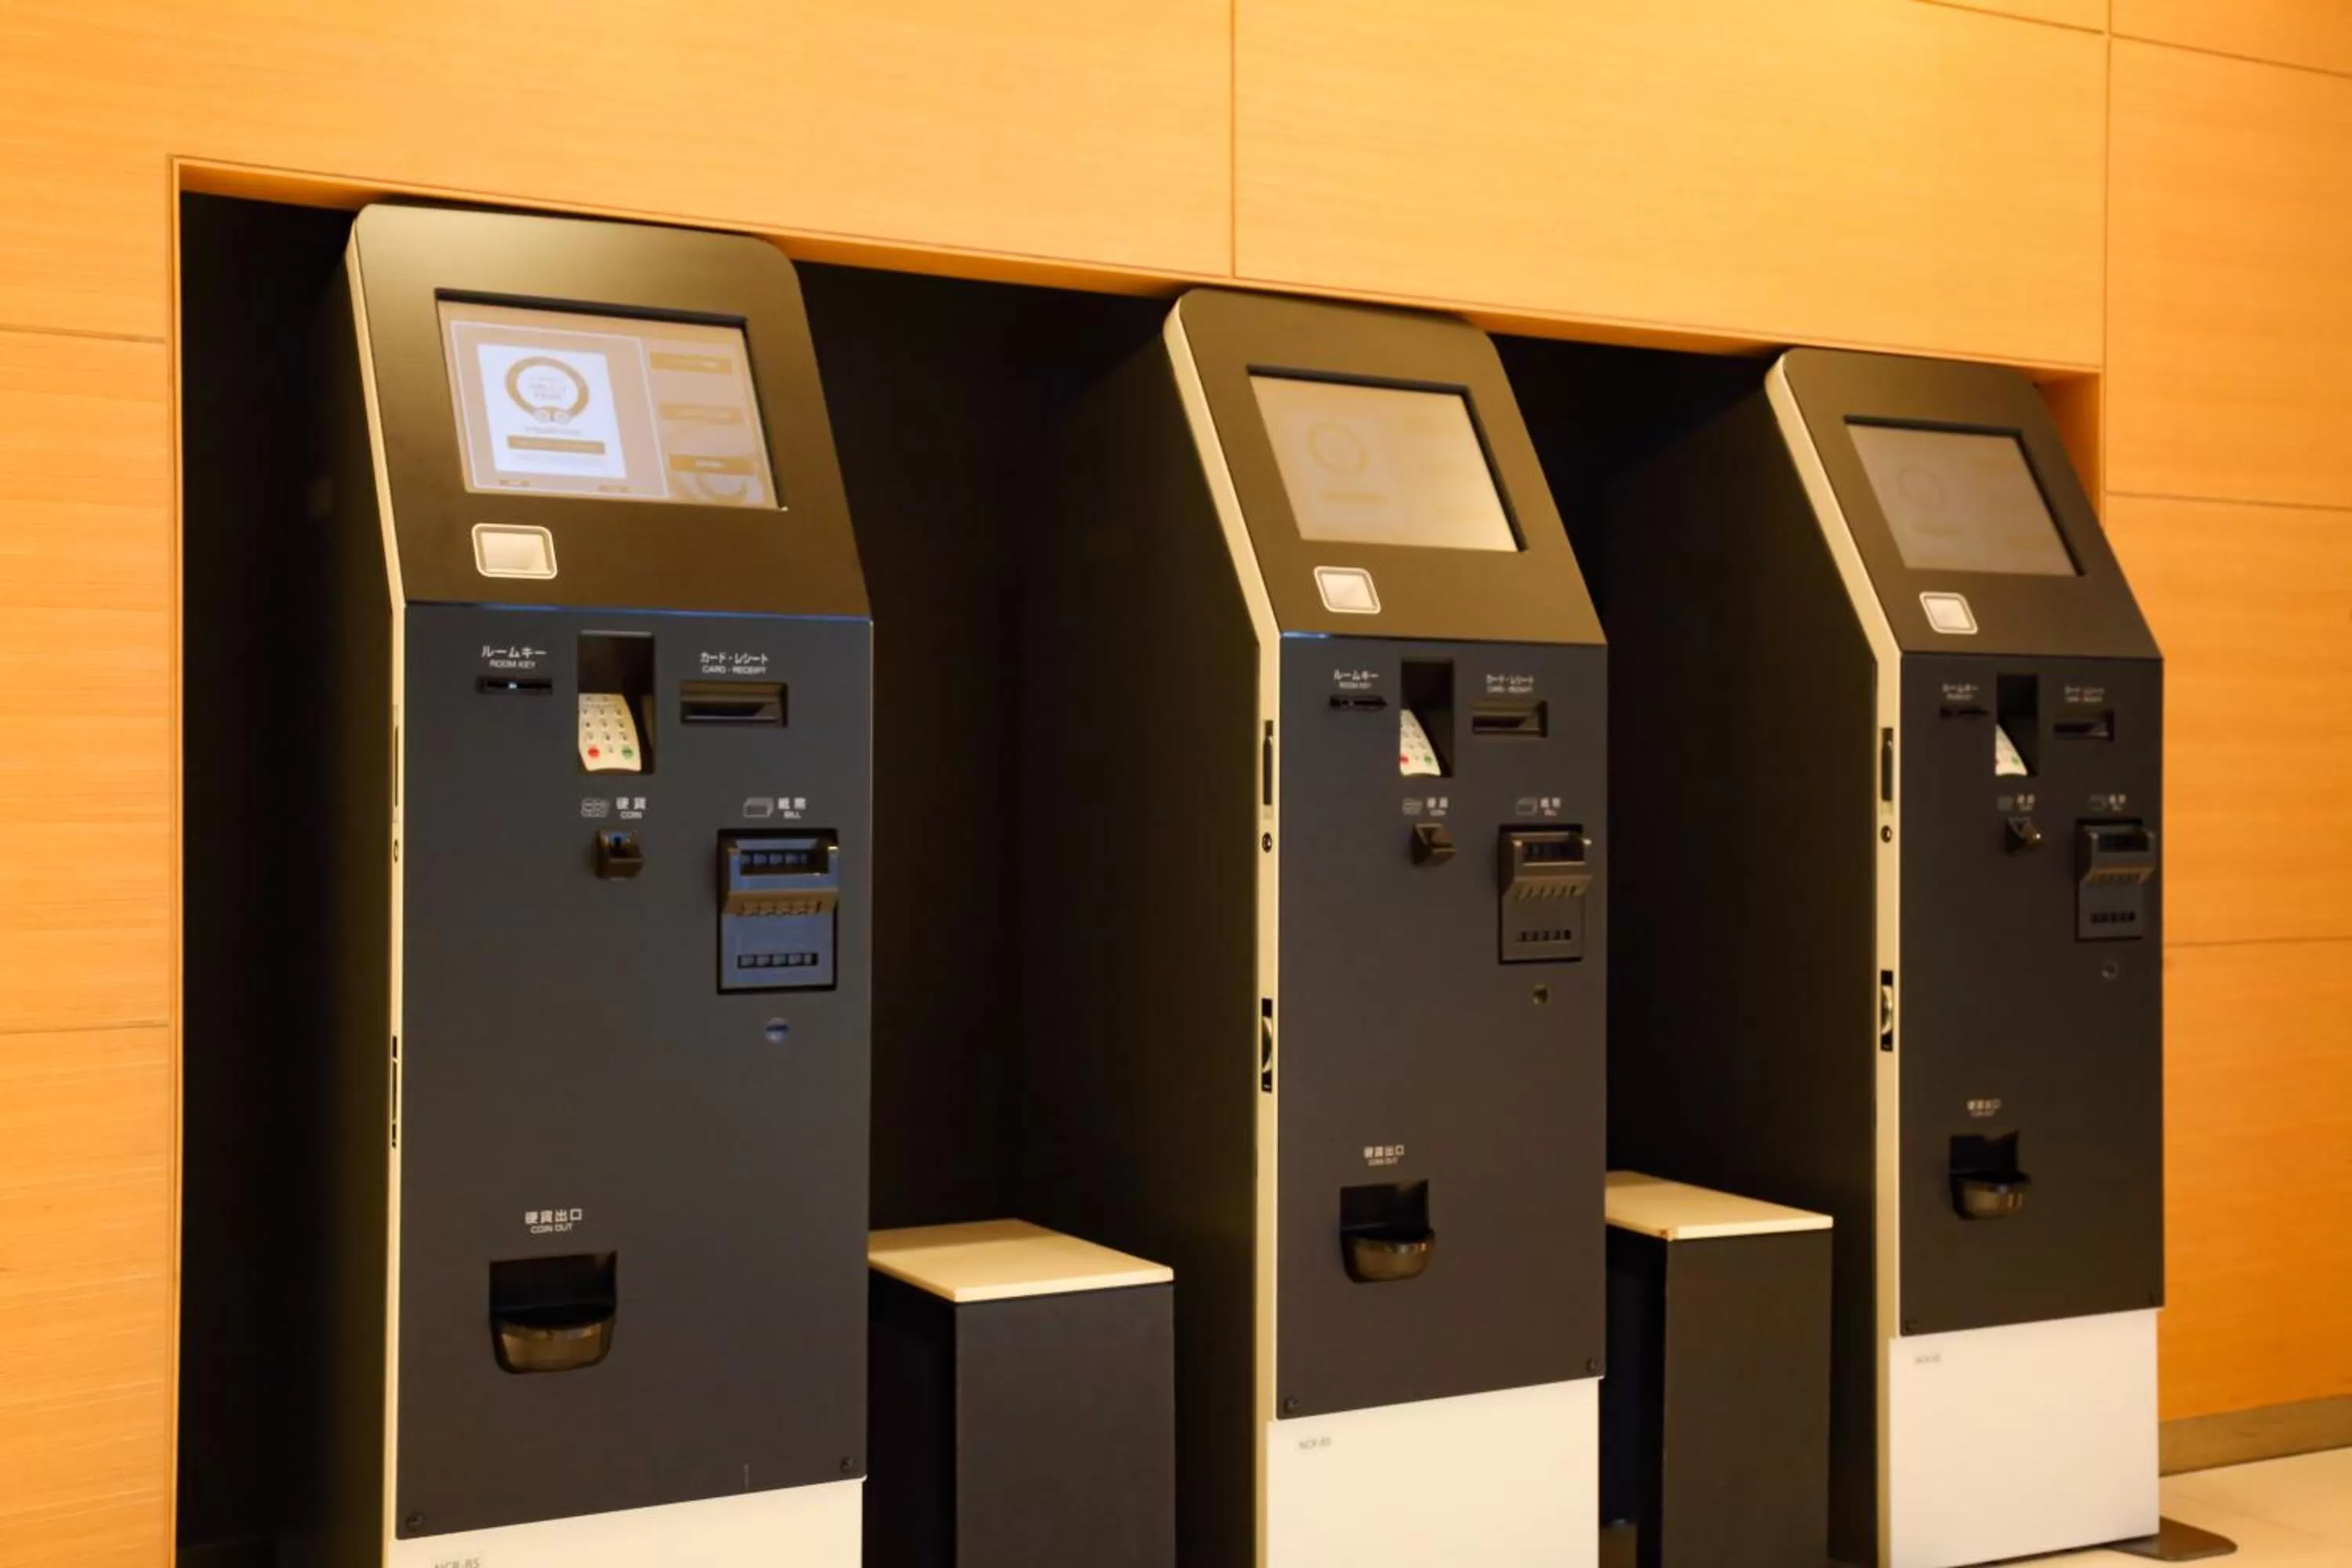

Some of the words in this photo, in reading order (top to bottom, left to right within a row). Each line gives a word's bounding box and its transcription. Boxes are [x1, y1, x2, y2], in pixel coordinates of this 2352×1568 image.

[481, 645, 547, 659] ルームキー
[488, 659, 517, 668] ROOM
[518, 659, 536, 669] KEY
[700, 652, 768, 665] カード・レシート
[702, 665, 727, 674] CARD
[620, 810, 642, 820] COIN
[524, 1208, 583, 1225] 硬貨出口
[531, 1225, 553, 1234] COIN
[554, 1222, 572, 1232] OUT
